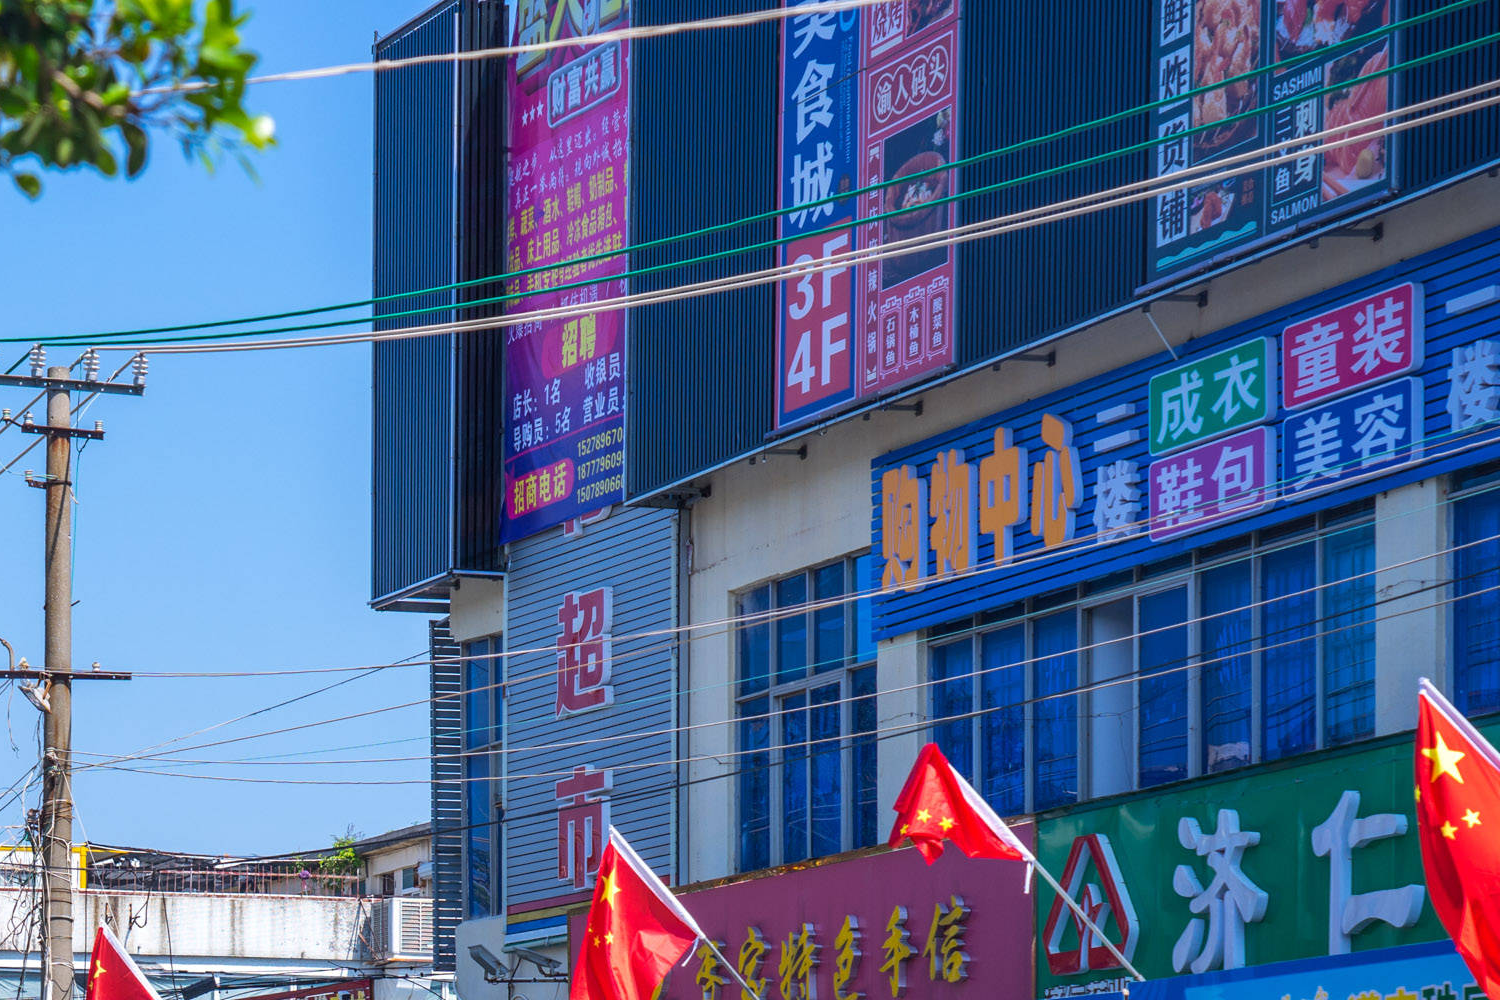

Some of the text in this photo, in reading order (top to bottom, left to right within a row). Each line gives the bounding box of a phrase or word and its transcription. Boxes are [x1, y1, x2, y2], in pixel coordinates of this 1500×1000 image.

[552, 46, 617, 118] 财富共赢
[1273, 67, 1322, 101] SASHIMI
[1270, 194, 1320, 226] SALMON
[788, 235, 849, 320] 3F
[561, 312, 597, 370] 招聘
[584, 352, 621, 390] 收银员
[786, 314, 849, 396] 4F
[1290, 297, 1406, 399] 童装
[544, 377, 562, 406] 1名
[555, 406, 571, 435] 5名
[1156, 354, 1260, 446] 成衣
[1094, 403, 1142, 545] 二楼
[1293, 391, 1407, 490] 美容
[513, 462, 567, 515] 招商电话
[881, 412, 1082, 596] 购物中心
[1156, 444, 1261, 528] 鞋包
[555, 586, 613, 890] 超市
[1172, 790, 1424, 972] 济仁
